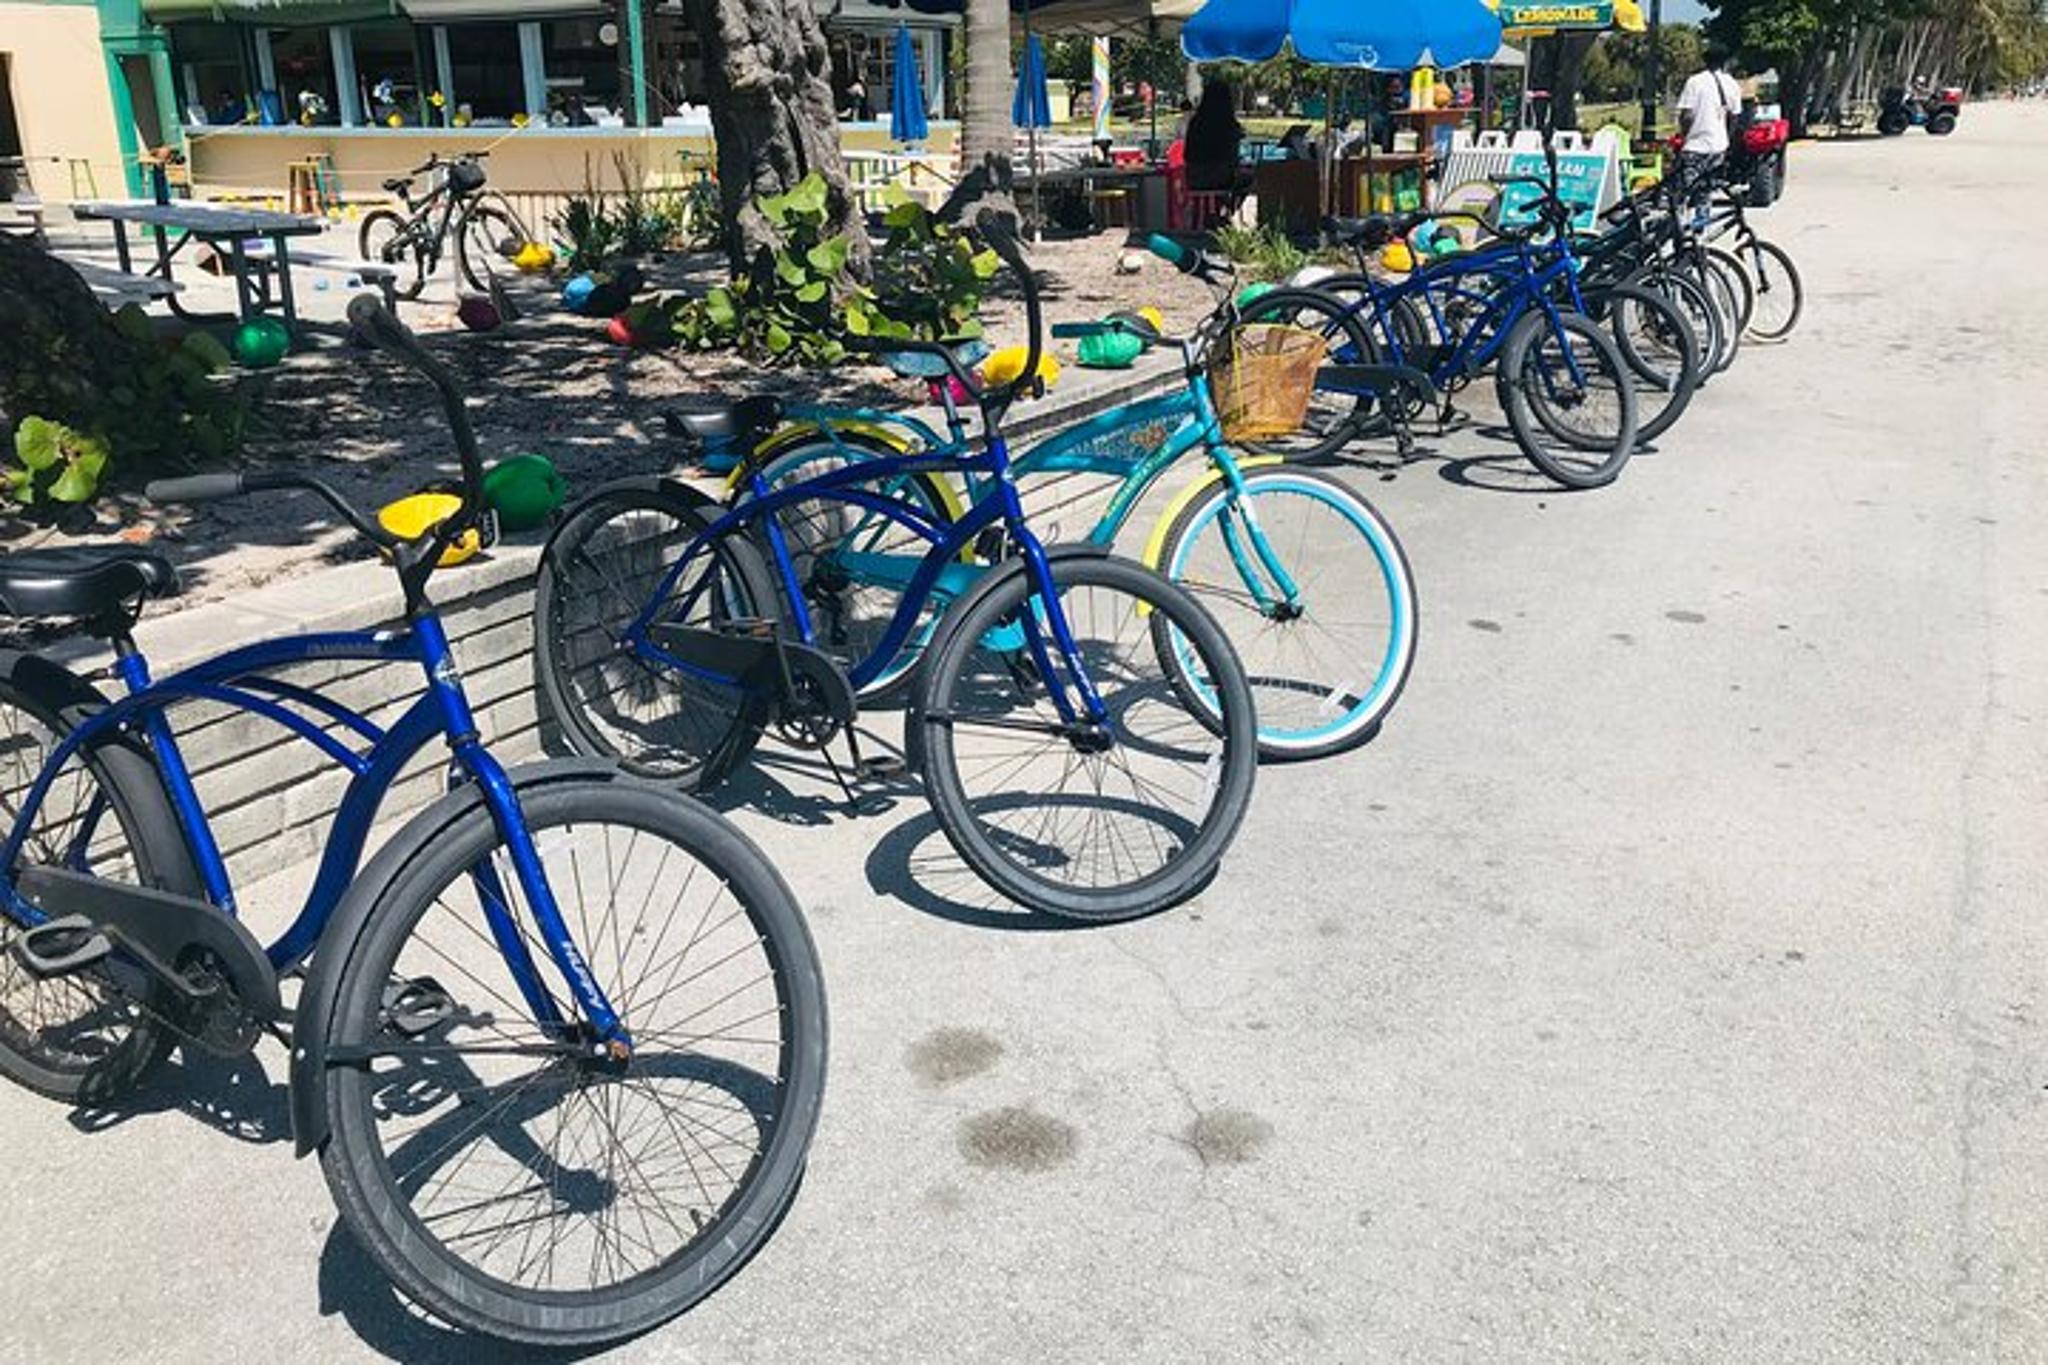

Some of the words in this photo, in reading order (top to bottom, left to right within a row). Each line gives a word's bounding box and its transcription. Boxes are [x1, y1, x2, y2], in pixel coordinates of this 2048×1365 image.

[1514, 8, 1599, 23] LEMONADE
[1538, 161, 1586, 177] CEAM
[561, 940, 606, 1010] HUFFY
